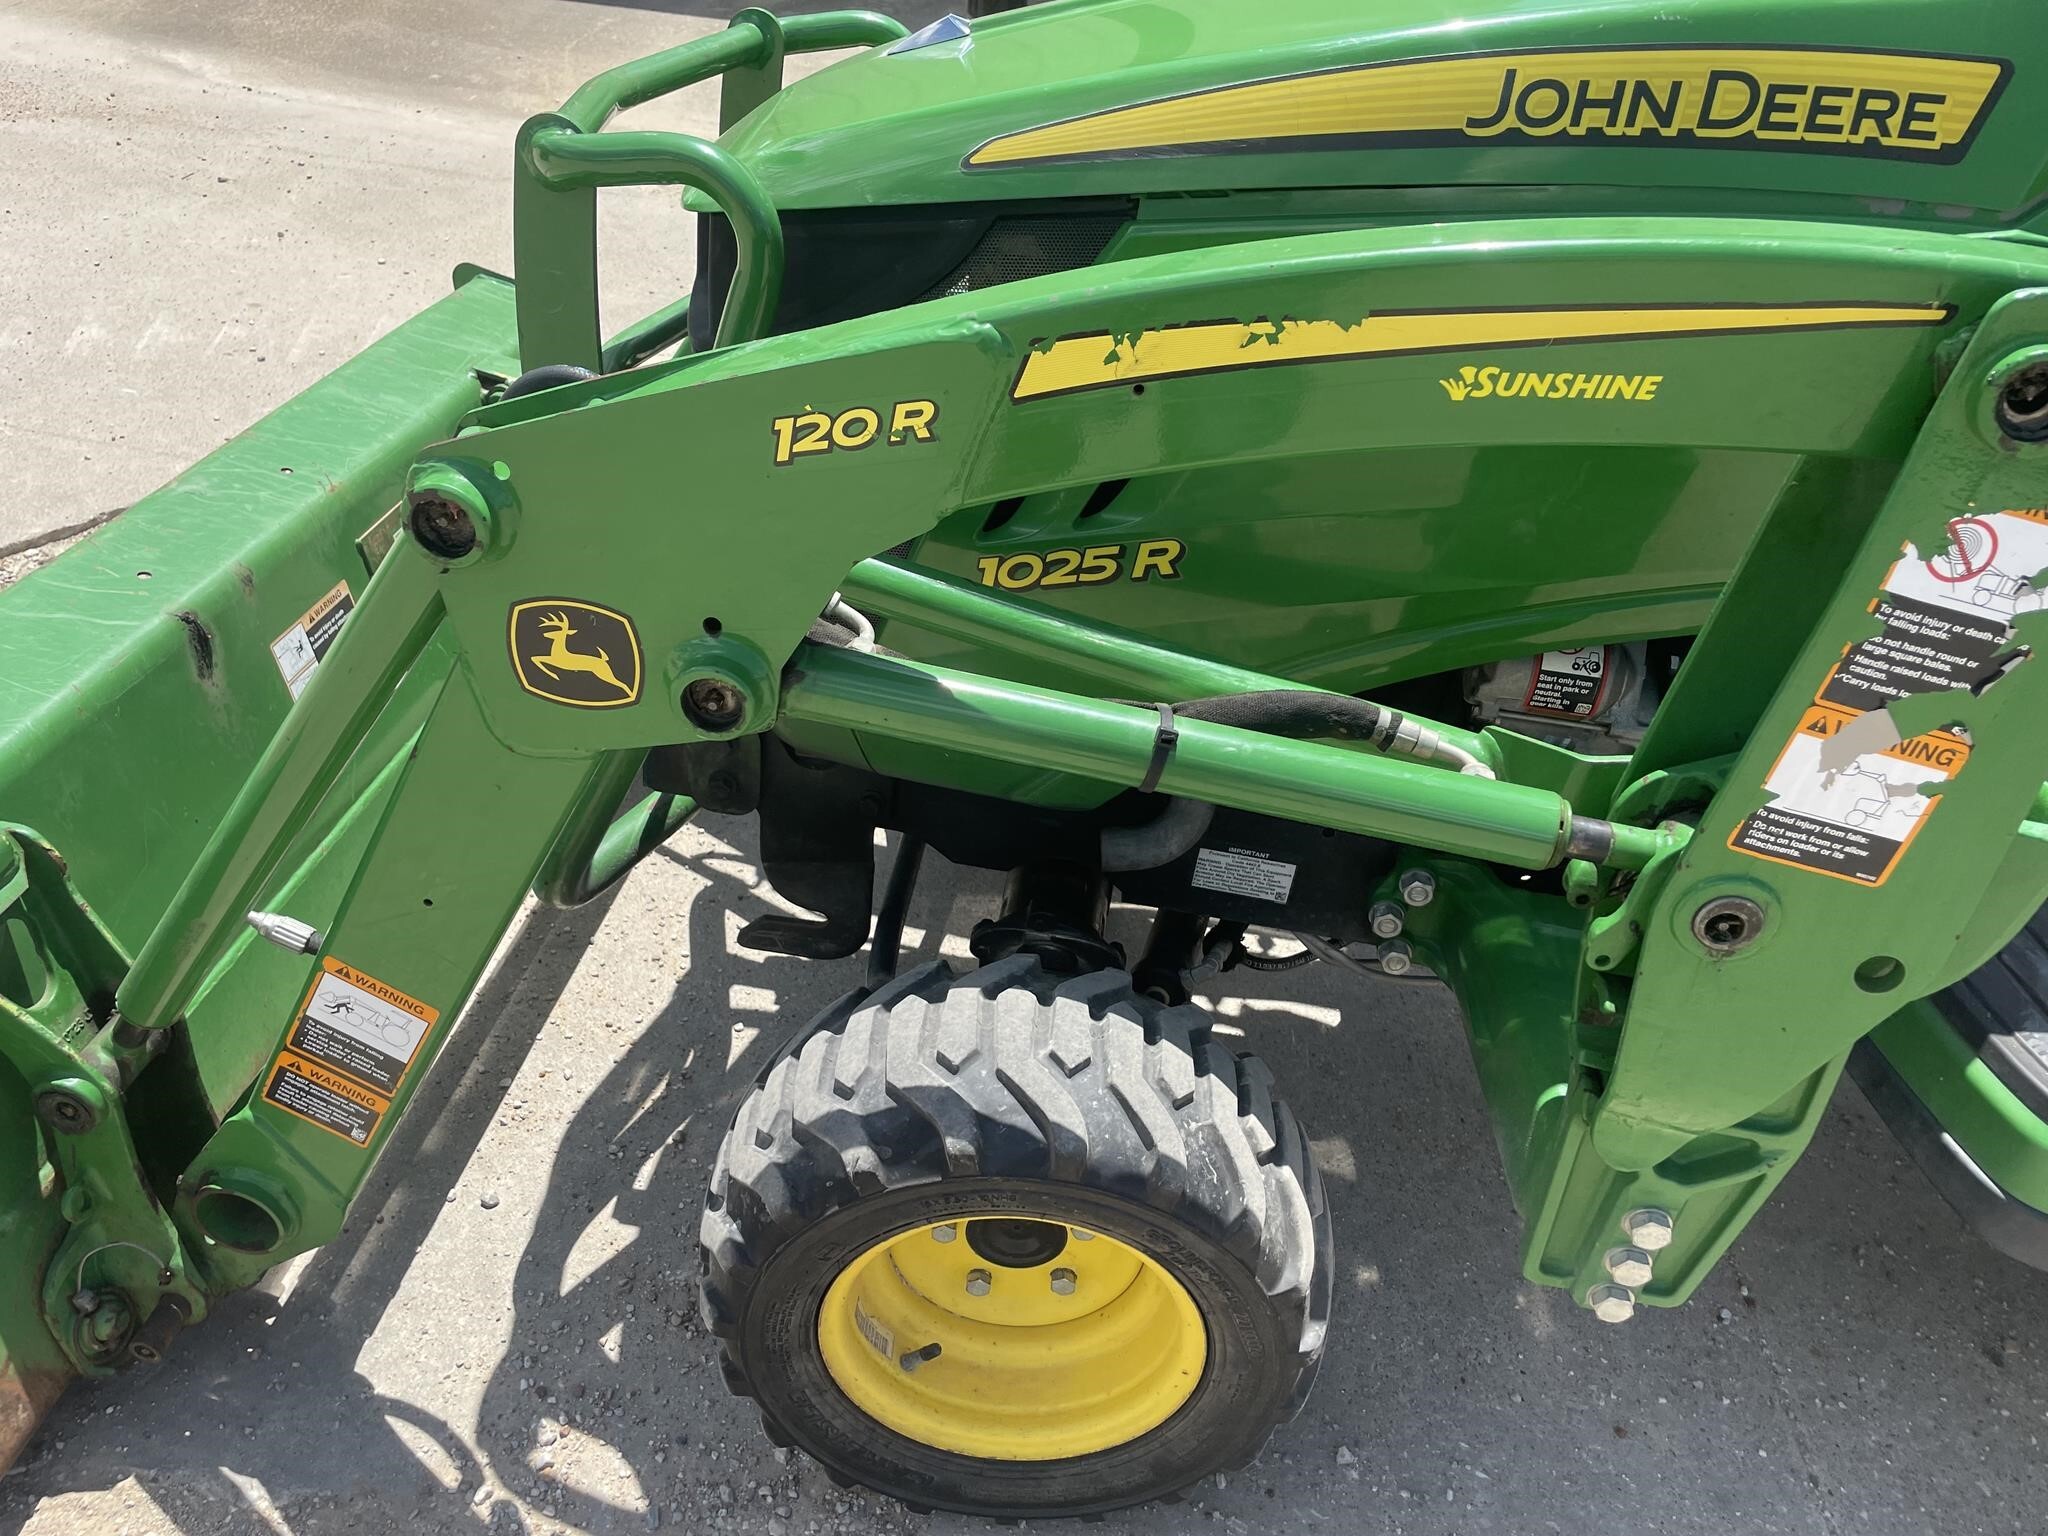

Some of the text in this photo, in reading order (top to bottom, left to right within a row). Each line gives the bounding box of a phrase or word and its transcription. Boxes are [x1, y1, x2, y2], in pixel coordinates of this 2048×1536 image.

[1465, 68, 1947, 141] JOHN DEERE
[1469, 366, 1664, 400] SUNSHINE
[772, 399, 940, 467] 120 R
[977, 537, 1185, 594] 1025 R
[314, 589, 342, 617] WARNING
[1880, 604, 1892, 613] To
[1893, 610, 1922, 622] avoid
[1922, 616, 1952, 630] injury
[1965, 628, 1993, 641] death
[1888, 618, 1950, 640] falling loads:
[1862, 642, 1951, 671] large square bales.
[1883, 639, 1902, 648] not
[1902, 642, 1935, 656] handle
[1936, 653, 1967, 665] round
[1539, 674, 1593, 687] Start only from
[1850, 665, 1886, 680] caution.
[1854, 655, 1889, 670] Handle
[1890, 666, 1921, 678] raised
[1922, 673, 1949, 685] loads
[1843, 675, 1870, 689] Carry
[1871, 683, 1897, 695] loads
[1753, 821, 1767, 830] Do
[1768, 826, 1784, 834] not
[1785, 831, 1808, 840] work
[1809, 836, 1831, 847] from
[1843, 846, 1869, 856] allow
[1768, 813, 1795, 824] avoid
[1795, 819, 1822, 832] injury
[1823, 827, 1845, 837] from
[1846, 833, 1869, 844] falls:
[1229, 847, 1270, 859] IMPORTANT
[1744, 838, 1800, 857] attachments.
[1748, 830, 1775, 841] riders
[1790, 840, 1820, 852] loader
[1832, 851, 1845, 859] its
[355, 975, 425, 1015] WARNING
[310, 1069, 376, 1106] WARNING
